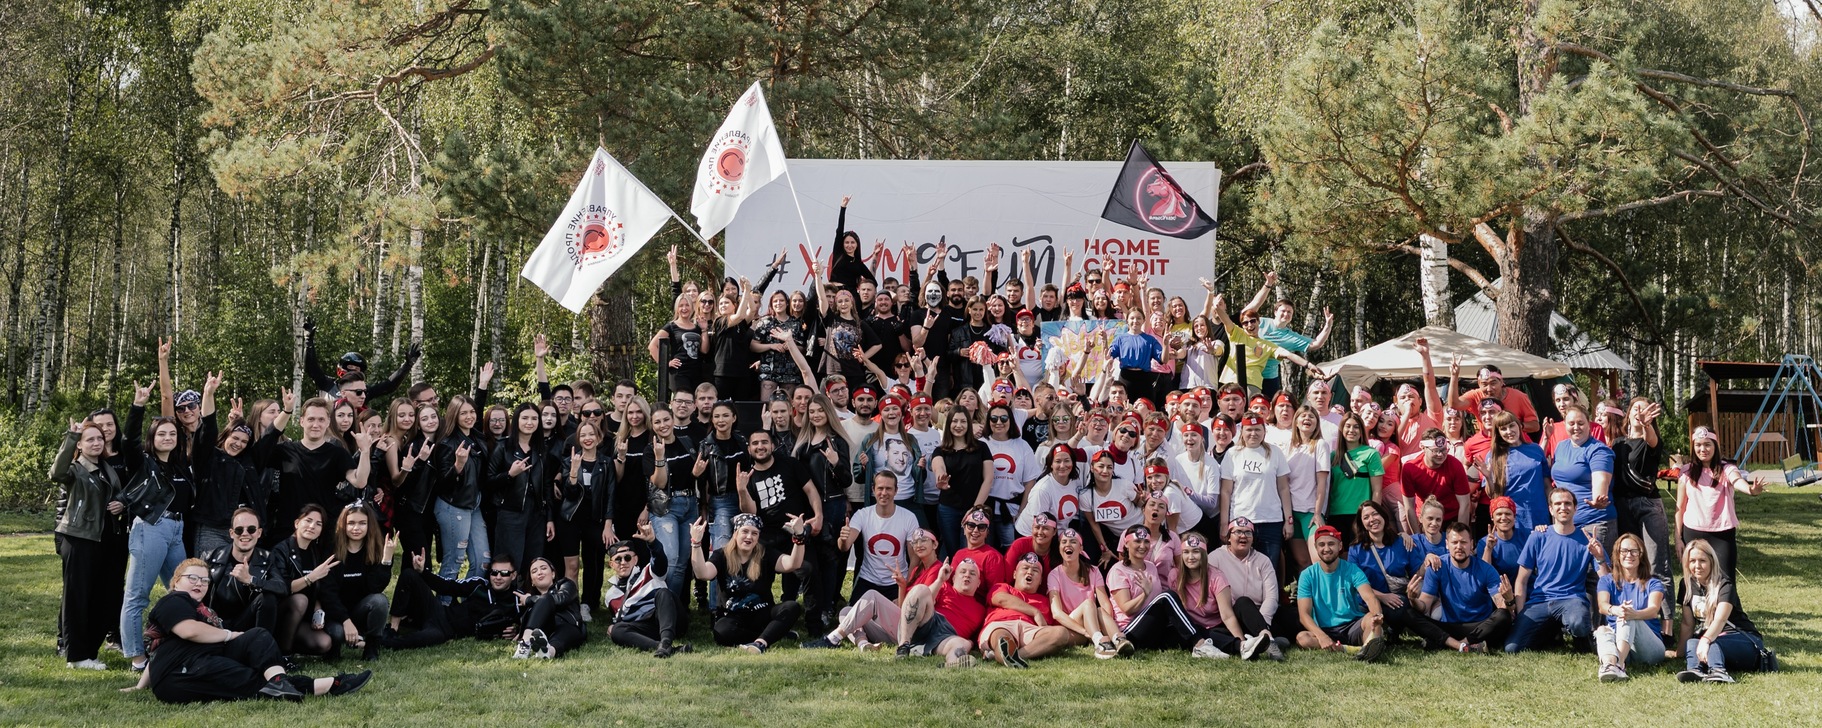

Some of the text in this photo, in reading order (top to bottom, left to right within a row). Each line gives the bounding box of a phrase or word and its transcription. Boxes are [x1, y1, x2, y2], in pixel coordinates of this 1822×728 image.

[1084, 238, 1160, 256] HOME
[1083, 257, 1169, 276] CREDIT
[1096, 508, 1120, 520] NPS
